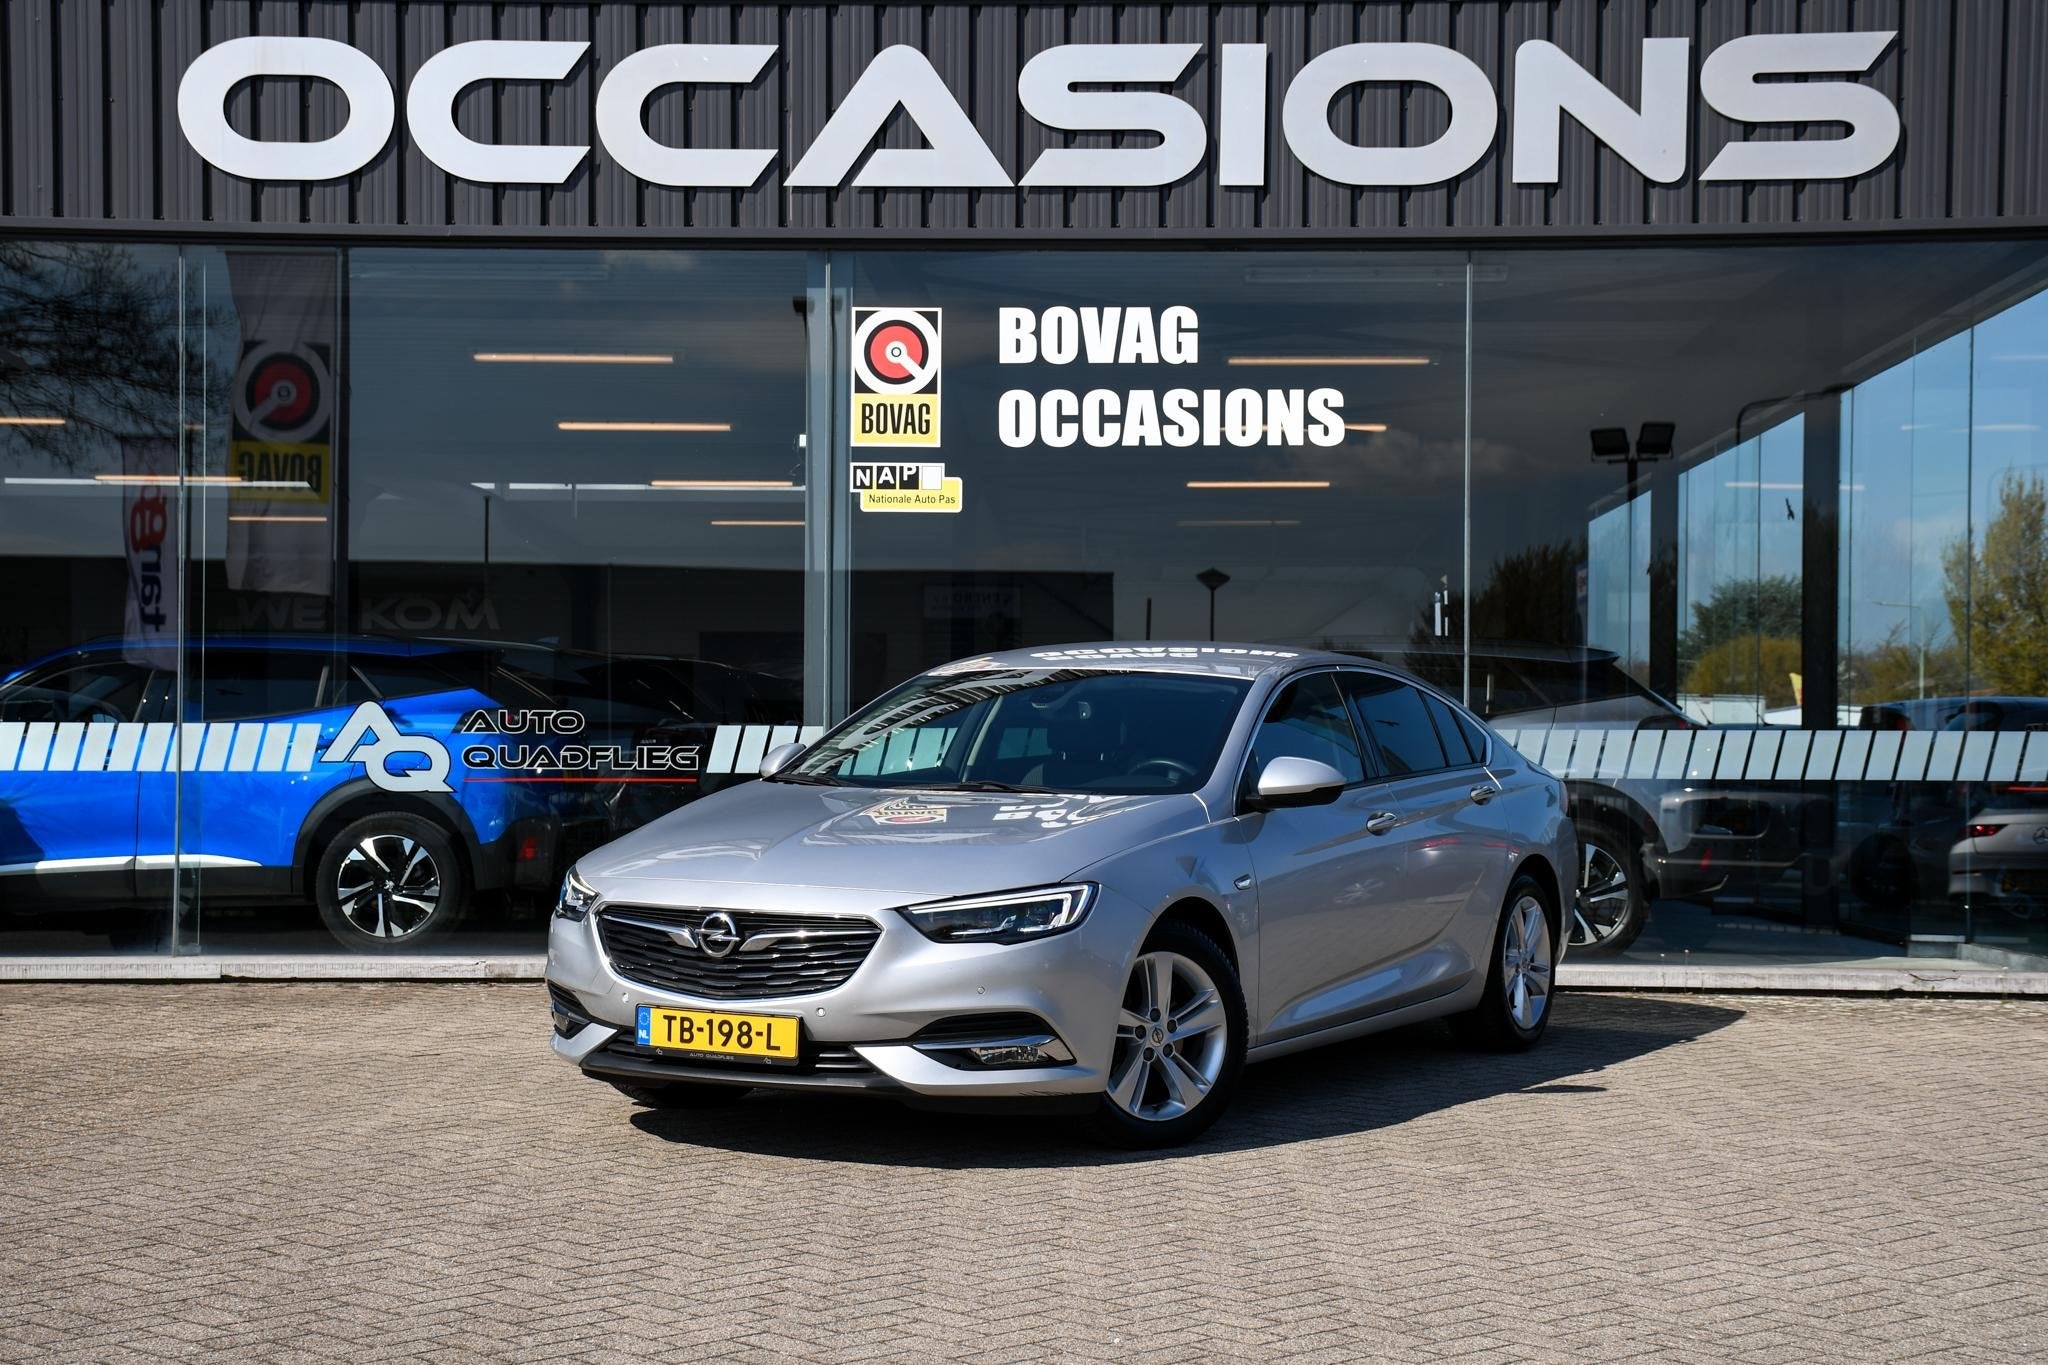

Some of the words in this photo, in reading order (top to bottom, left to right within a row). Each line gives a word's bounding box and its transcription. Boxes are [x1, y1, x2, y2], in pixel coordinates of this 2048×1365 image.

[178, 30, 1900, 188] OCCASIONS
[1000, 305, 1199, 365] BOVAG
[861, 403, 930, 435] BOVAG
[998, 387, 1345, 448] OCCASIONS
[856, 465, 917, 487] NAP
[868, 494, 912, 504] Nationale
[914, 494, 936, 504] Auto
[938, 494, 956, 504] Pas
[237, 596, 501, 630] WEKOM
[460, 709, 585, 734] AUTO
[460, 745, 700, 771] QUADFLIEG
[638, 1030, 649, 1039] NL
[663, 1015, 781, 1051] TB-198-L
